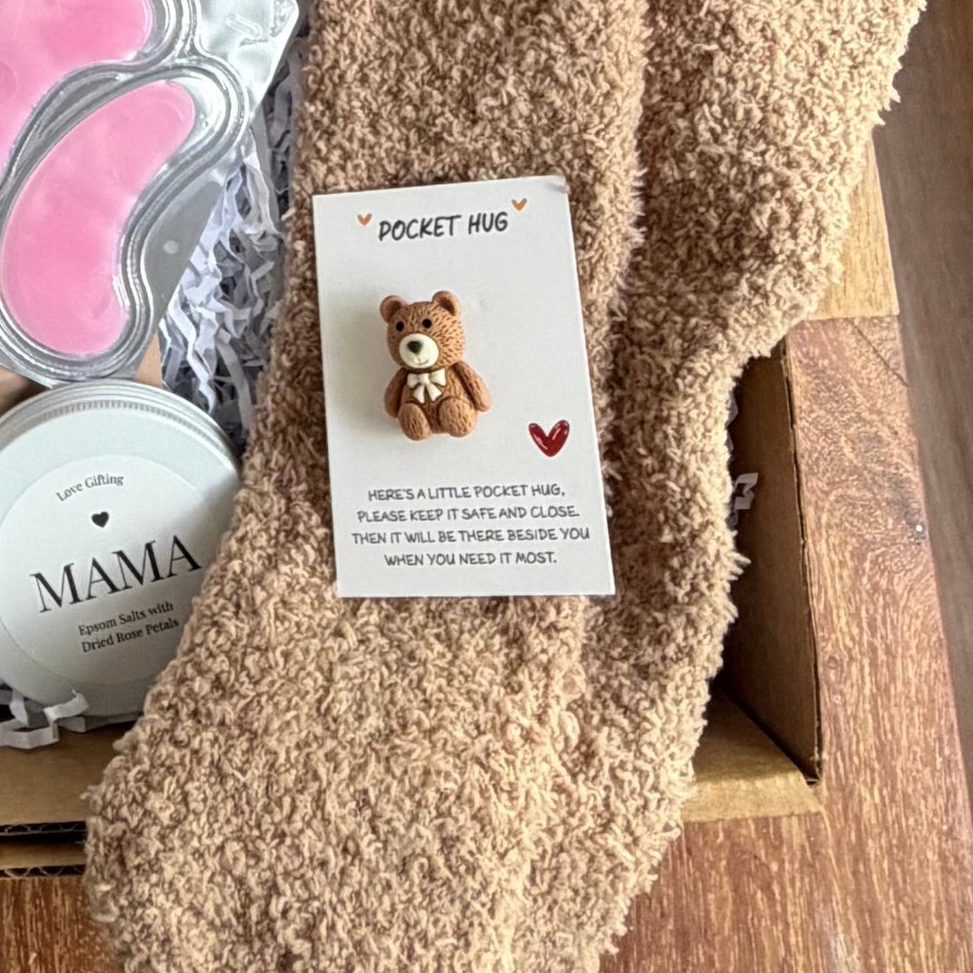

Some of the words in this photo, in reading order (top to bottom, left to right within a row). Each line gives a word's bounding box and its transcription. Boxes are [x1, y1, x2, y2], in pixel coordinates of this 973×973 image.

[378, 214, 461, 241] POCKET
[468, 211, 509, 234] HUG
[56, 482, 83, 502] Love
[84, 473, 124, 488] Gifting
[368, 488, 414, 502] HERE'S
[417, 489, 426, 500] A
[428, 487, 471, 500] LITTLE
[474, 484, 528, 498] POCKET
[357, 510, 407, 523] PLEASE
[410, 508, 444, 522] KEEP
[447, 508, 458, 520] IT
[461, 507, 496, 520] SAFE
[498, 506, 527, 519] AND
[351, 532, 387, 545] THEN
[390, 532, 402, 544] IT
[404, 531, 435, 544] WILL
[438, 530, 457, 543] BE
[458, 529, 505, 542] THERE
[507, 528, 558, 541] BESIDE
[560, 527, 590, 540] YOU
[384, 553, 423, 566] WHEN
[427, 553, 455, 566] YOU
[459, 552, 496, 565] NEED
[500, 552, 512, 564] IT
[515, 551, 557, 565] MOST.
[29, 534, 203, 613] MAMA
[78, 617, 117, 636] Epsom
[120, 609, 146, 625] Salts
[148, 601, 174, 617] with
[81, 635, 114, 653] Dried
[117, 628, 144, 644] Rose
[146, 618, 180, 636] Petals
